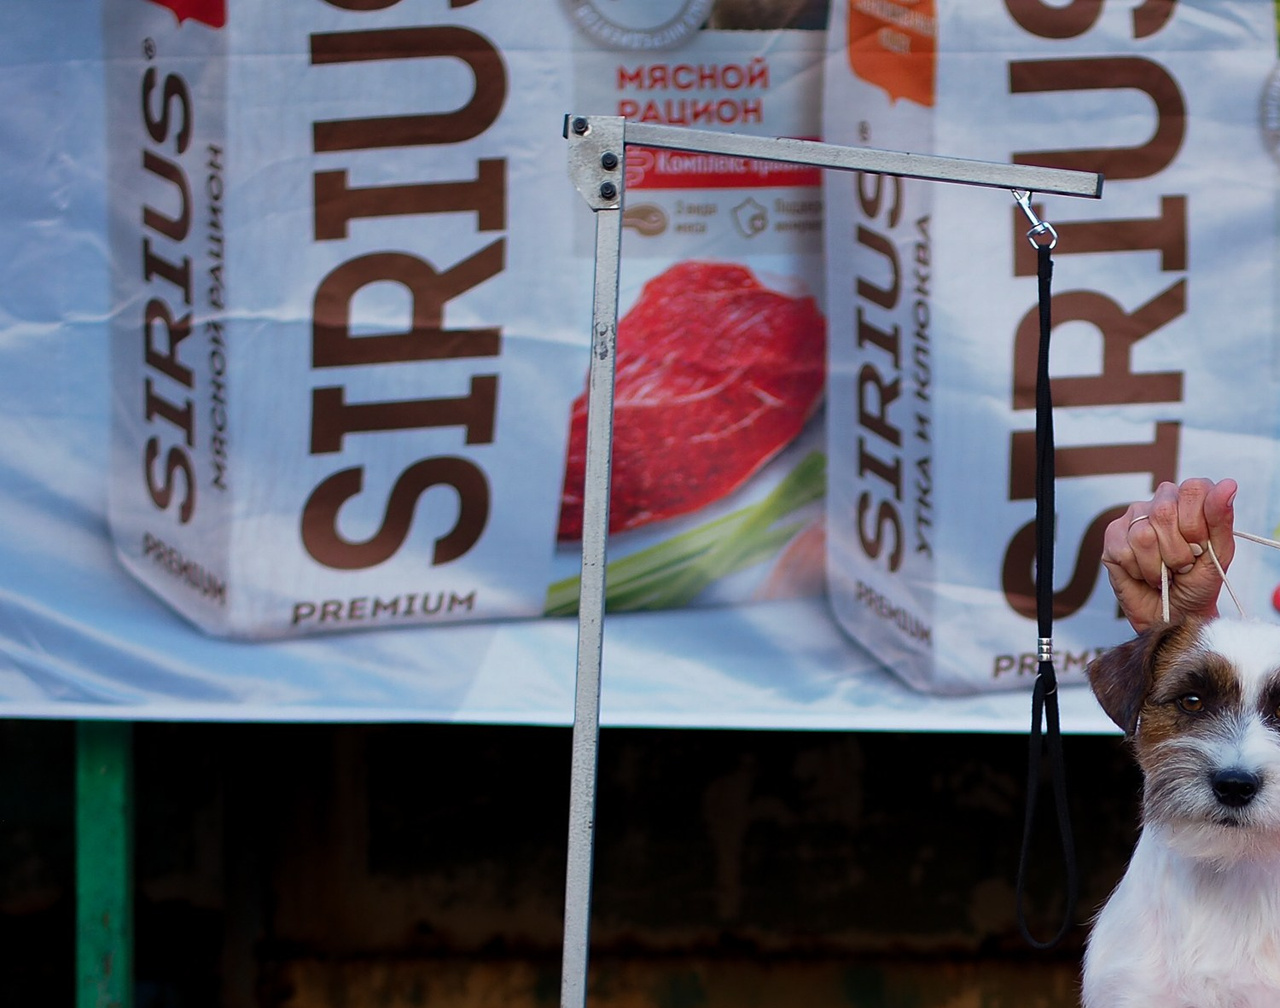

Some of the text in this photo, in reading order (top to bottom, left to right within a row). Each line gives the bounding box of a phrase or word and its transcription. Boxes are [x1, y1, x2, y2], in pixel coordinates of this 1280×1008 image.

[617, 57, 770, 91] МЯСНОЙ
[618, 98, 764, 126] РАЦИОН
[206, 144, 225, 310] РАЦИОН
[301, 0, 508, 572] SIRIU
[911, 214, 934, 559] УТКА И КЛЮКВА
[291, 590, 477, 625] PREMIUM
